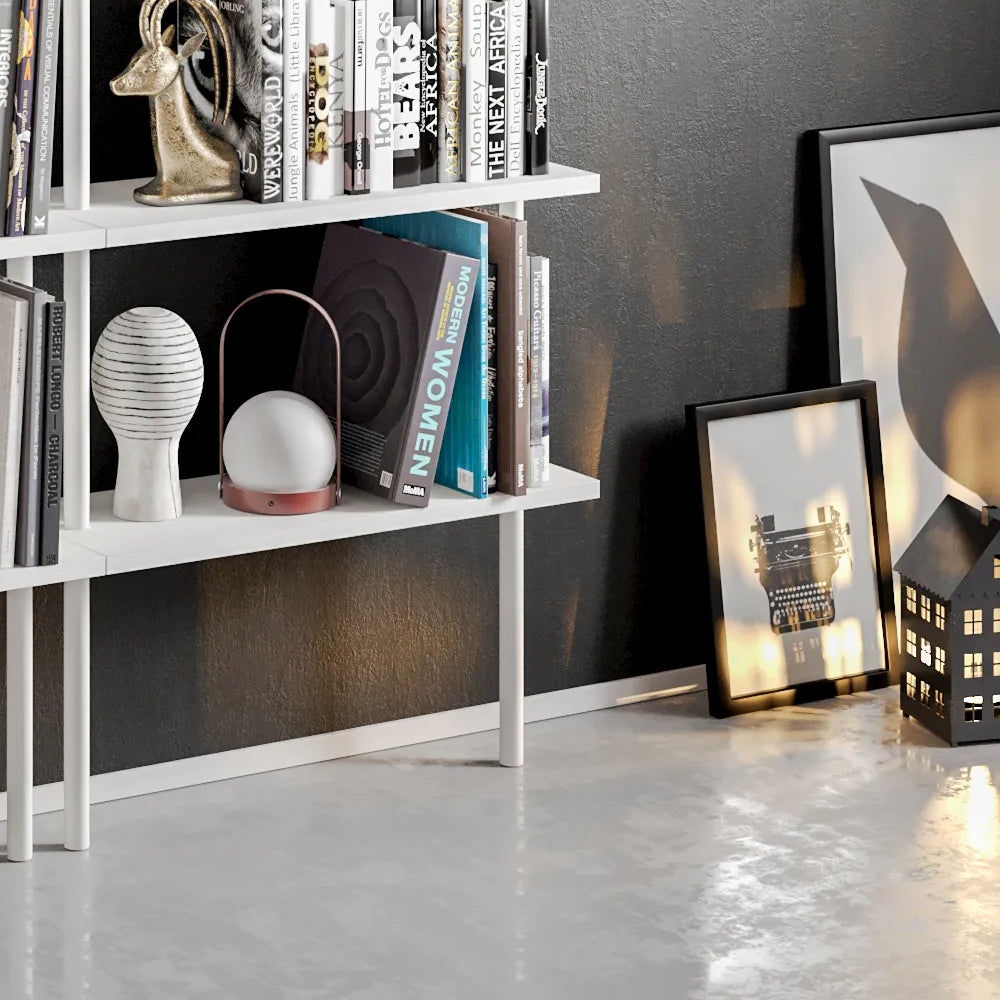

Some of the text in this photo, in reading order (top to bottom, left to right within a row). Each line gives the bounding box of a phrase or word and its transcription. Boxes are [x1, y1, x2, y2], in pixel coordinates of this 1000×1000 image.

[45, 39, 53, 52] OF
[218, 0, 245, 14] JOBLING
[420, 39, 427, 49] of
[513, 14, 524, 30] of
[43, 53, 52, 85] VISUAL
[290, 43, 301, 82] (Little
[328, 52, 344, 149] KENYA
[373, 11, 391, 149] HOTEL FOR DOGS
[393, 21, 422, 151] BEARS
[426, 34, 438, 138] AFRICA
[470, 3, 487, 167] Monkey Soup
[489, 4, 506, 179] THE NEXT AFRICA
[510, 34, 524, 135] Encyclopedia
[39, 86, 51, 162] COMMUNICATION
[263, 76, 283, 200] WEREWORLD
[289, 92, 299, 150] Animals
[315, 56, 329, 152] DOG
[445, 80, 460, 176] AFRICAN
[288, 155, 300, 201] Jungle
[355, 132, 363, 160] George
[510, 145, 520, 173] Dell
[446, 265, 472, 344] MODERN
[533, 271, 543, 351] Picasso Guitars
[47, 305, 64, 508] ROBERT LONGO CHARCOAL
[516, 330, 525, 408] tangled alphabets
[410, 348, 454, 477] WOMEN
[402, 484, 425, 497] MoMA
